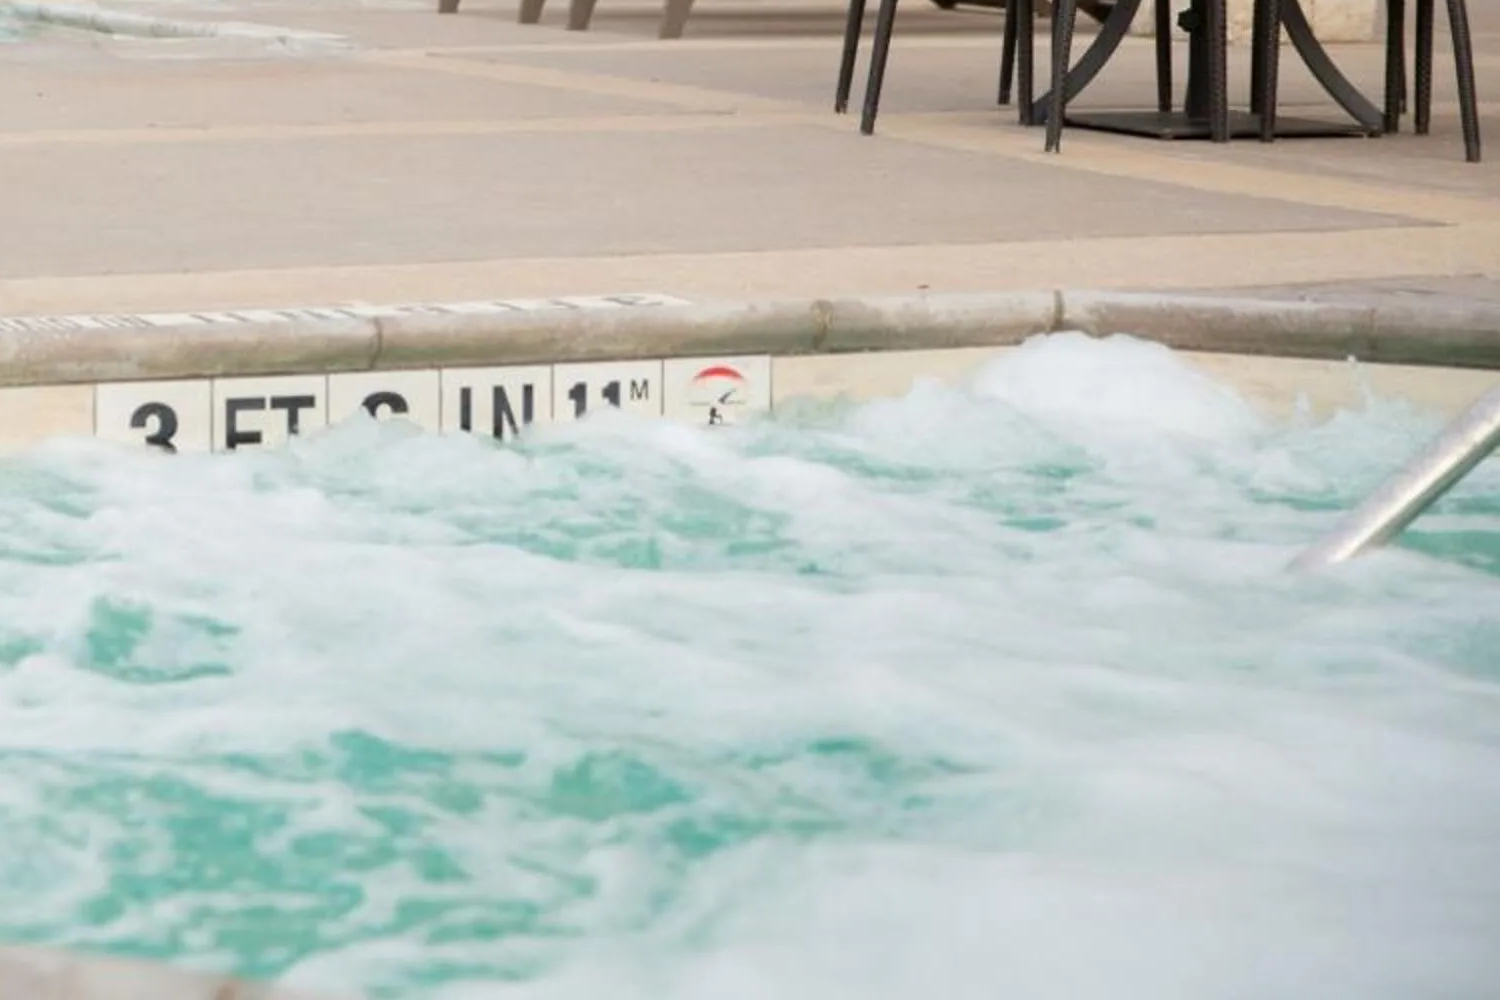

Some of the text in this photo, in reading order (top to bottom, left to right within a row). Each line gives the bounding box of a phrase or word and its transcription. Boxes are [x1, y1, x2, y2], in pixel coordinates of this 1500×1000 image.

[130, 402, 178, 453] 3
[226, 395, 315, 449] FT
[460, 383, 534, 440] IN
